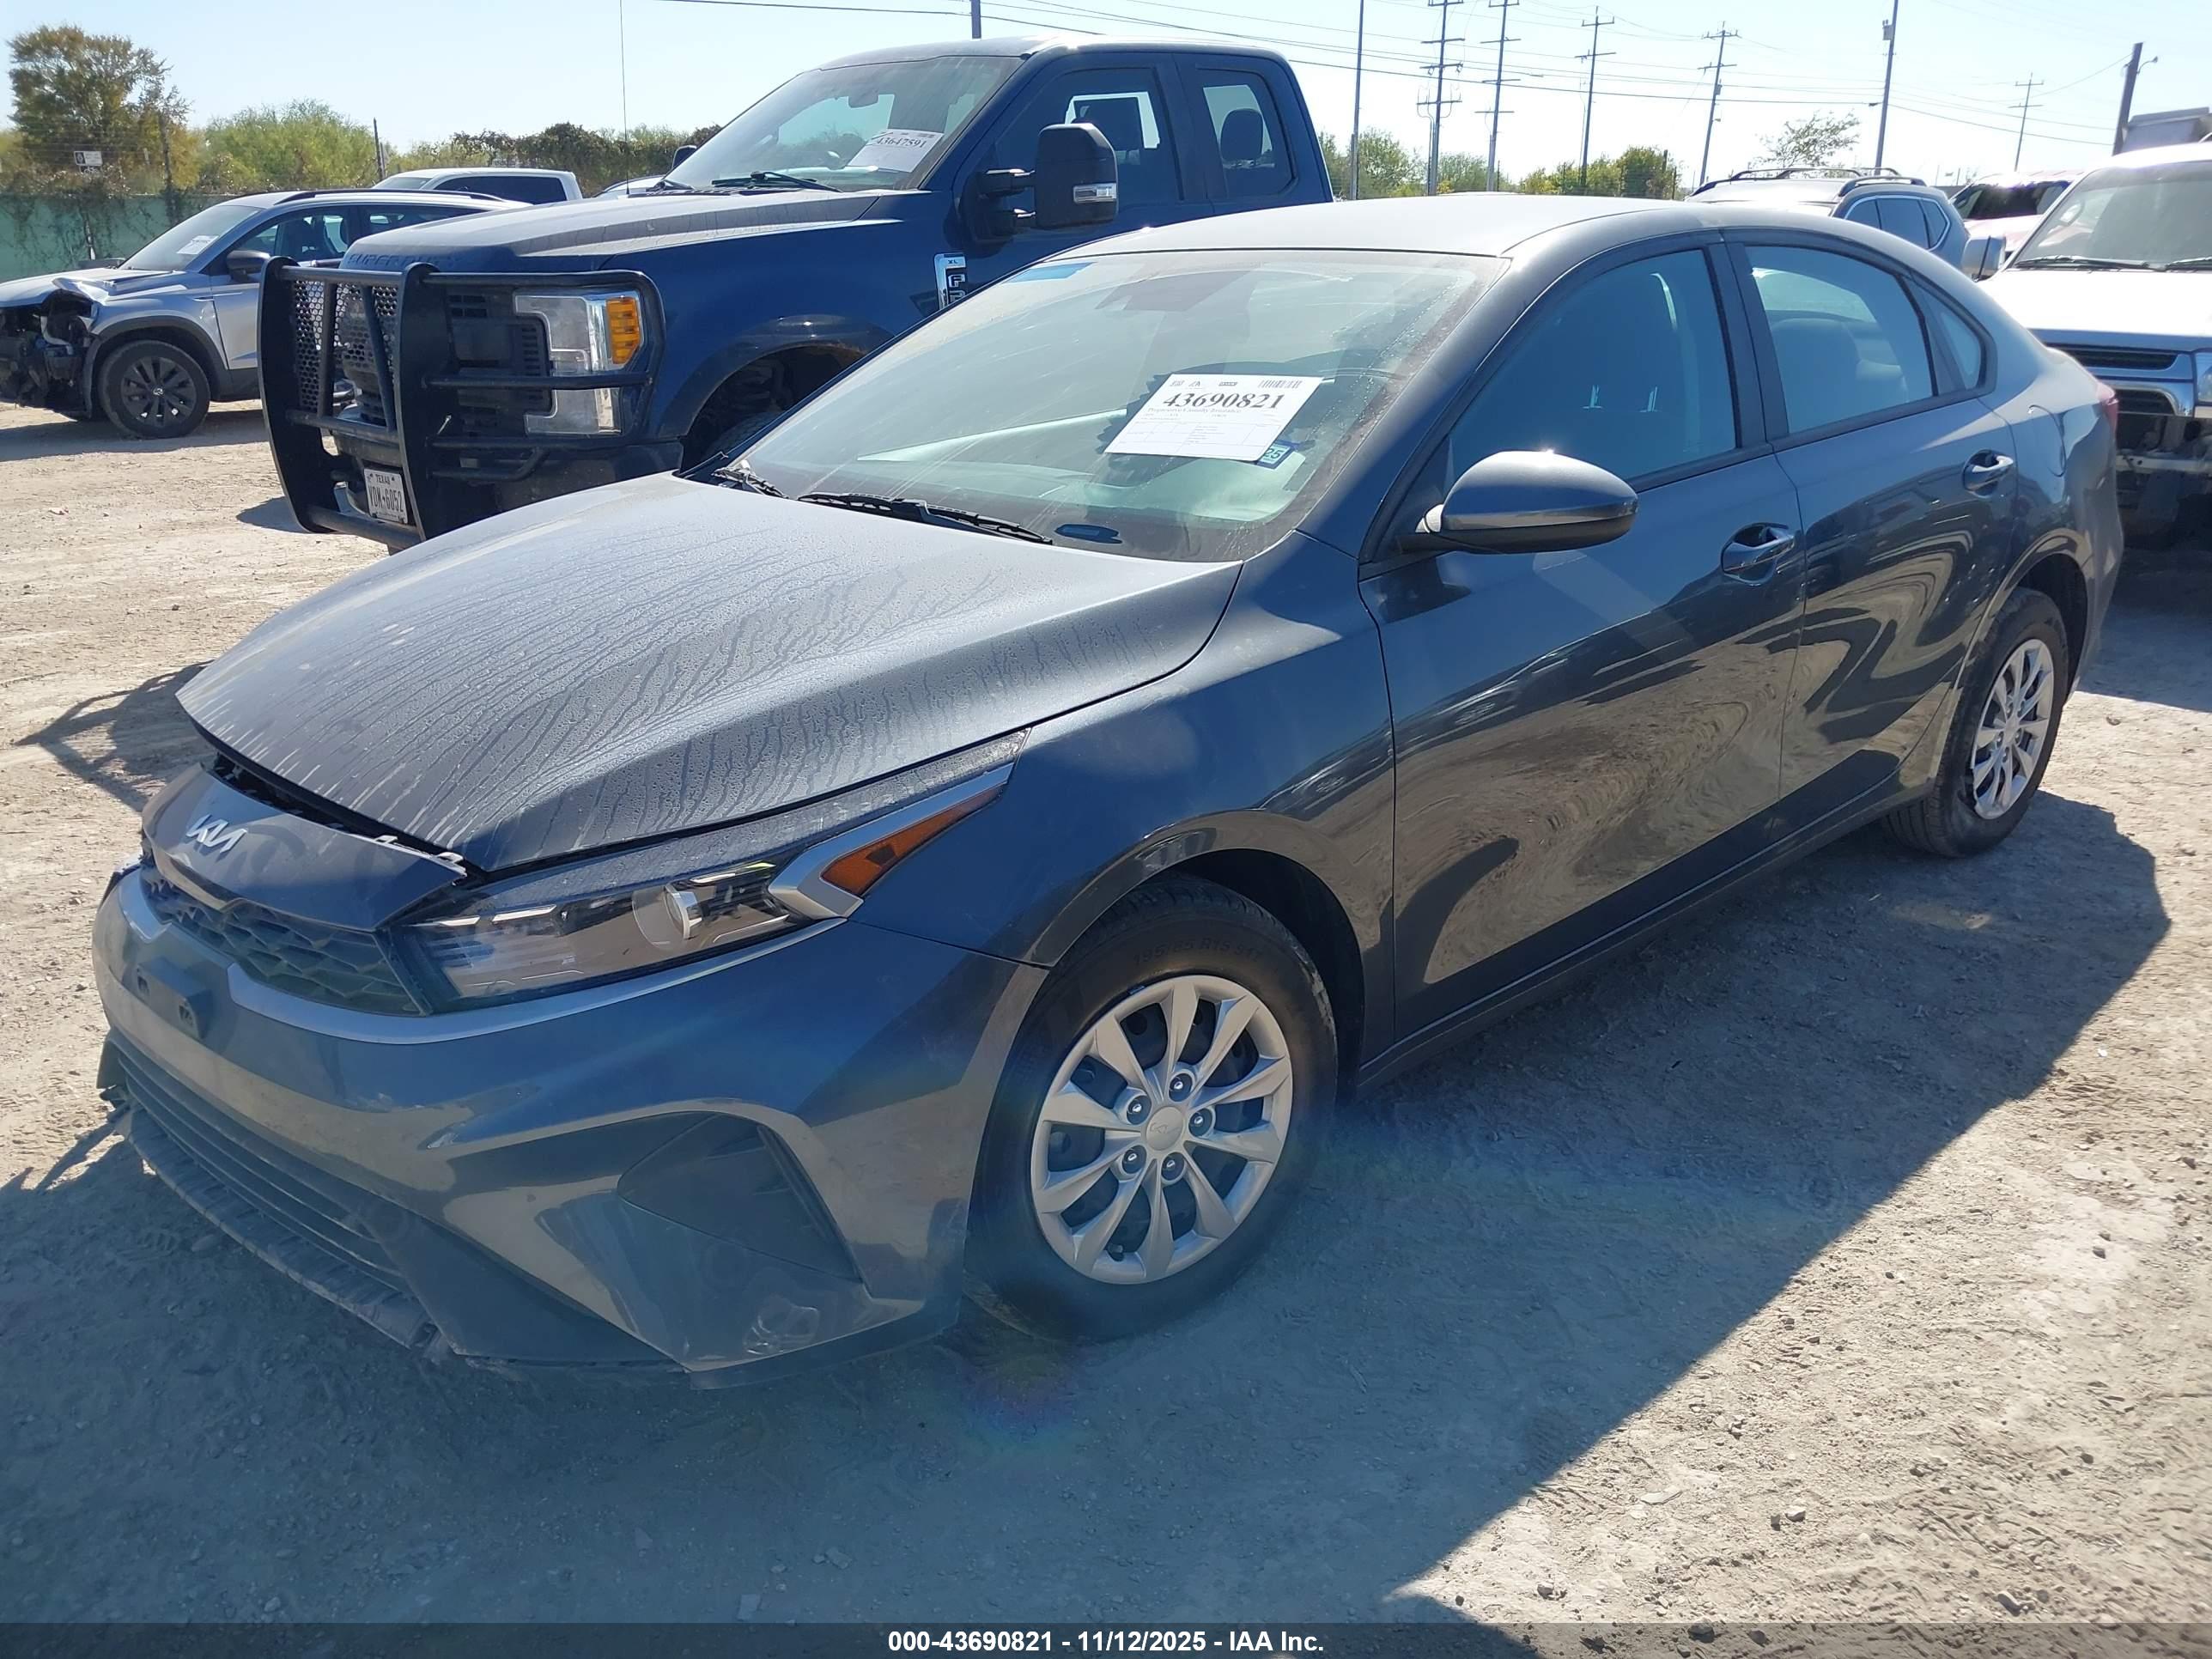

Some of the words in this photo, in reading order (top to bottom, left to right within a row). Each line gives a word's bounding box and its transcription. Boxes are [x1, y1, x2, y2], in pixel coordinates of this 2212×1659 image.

[877, 137, 927, 148] 43647591
[1164, 392, 1285, 410] 43690821
[1263, 447, 1285, 459] 25
[375, 473, 391, 485] TEXAS
[185, 813, 247, 854] KIA
